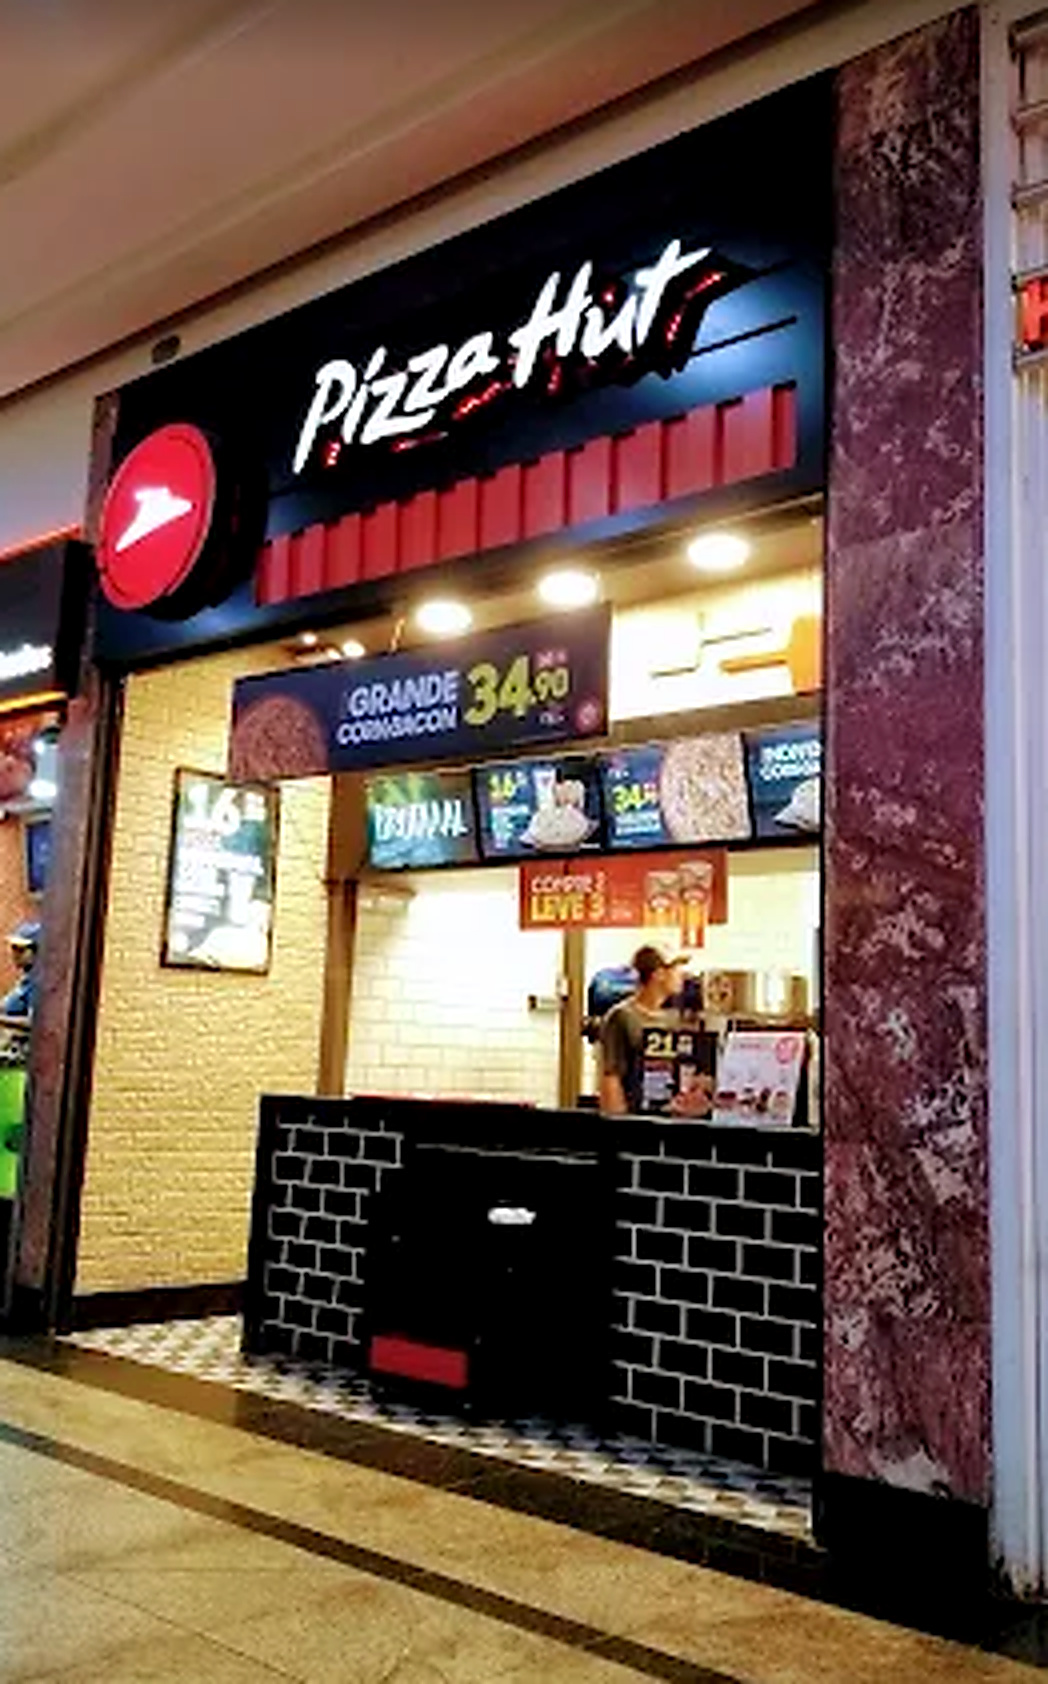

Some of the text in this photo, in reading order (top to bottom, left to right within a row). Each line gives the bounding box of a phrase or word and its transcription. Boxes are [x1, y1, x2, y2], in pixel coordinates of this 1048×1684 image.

[293, 239, 711, 475] Pizza Hut
[349, 670, 460, 718] GRANDE
[531, 894, 585, 921] LEVE
[589, 893, 605, 921] 3
